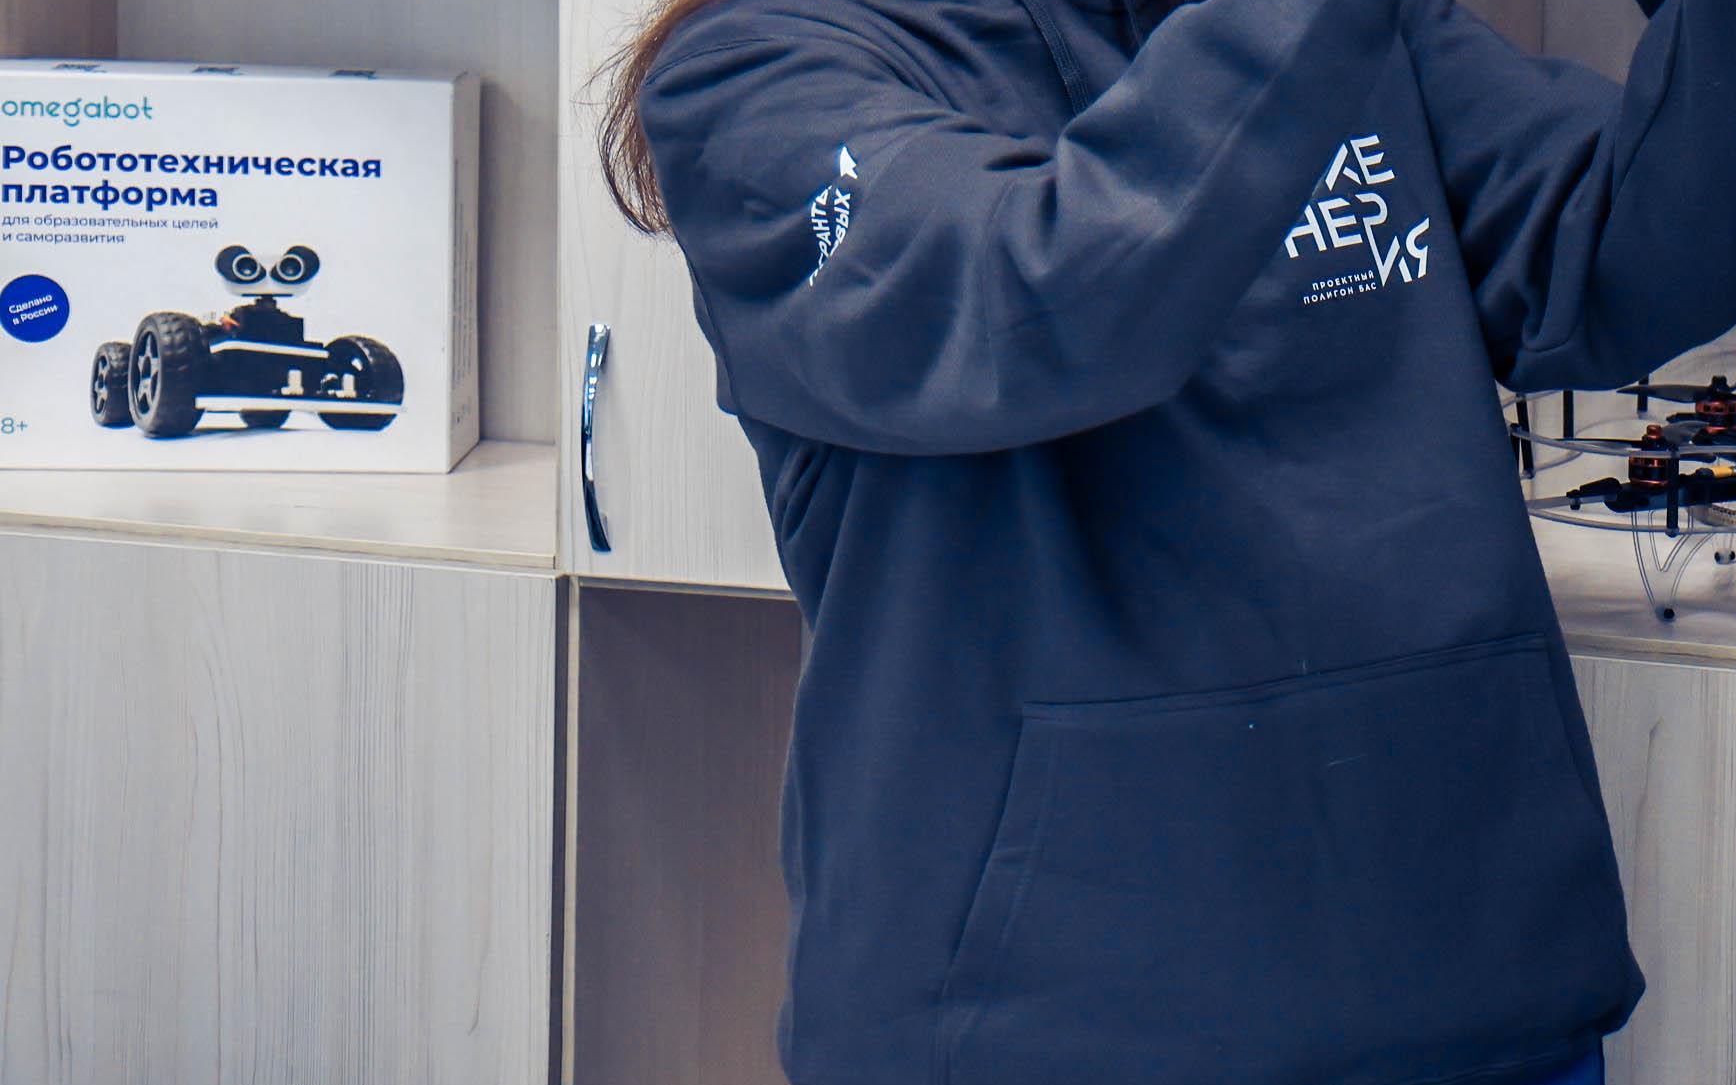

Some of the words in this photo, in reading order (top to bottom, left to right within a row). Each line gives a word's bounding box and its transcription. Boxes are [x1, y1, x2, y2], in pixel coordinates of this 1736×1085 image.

[1, 96, 153, 127] omegabot
[2, 145, 381, 179] Робототехническая
[2, 180, 218, 212] платформа
[2, 215, 30, 227] для
[34, 214, 168, 229] образовательных
[172, 218, 219, 230] целей
[2, 233, 12, 242] и
[16, 232, 125, 244] саморазвития
[1312, 269, 1375, 291] ПРОЕКТНЫЙ
[8, 294, 53, 314] Сделано
[1303, 287, 1354, 305] ПОЛИГОН
[1359, 282, 1377, 293] БАС
[20, 304, 59, 322] России
[1, 417, 28, 434] 8+
